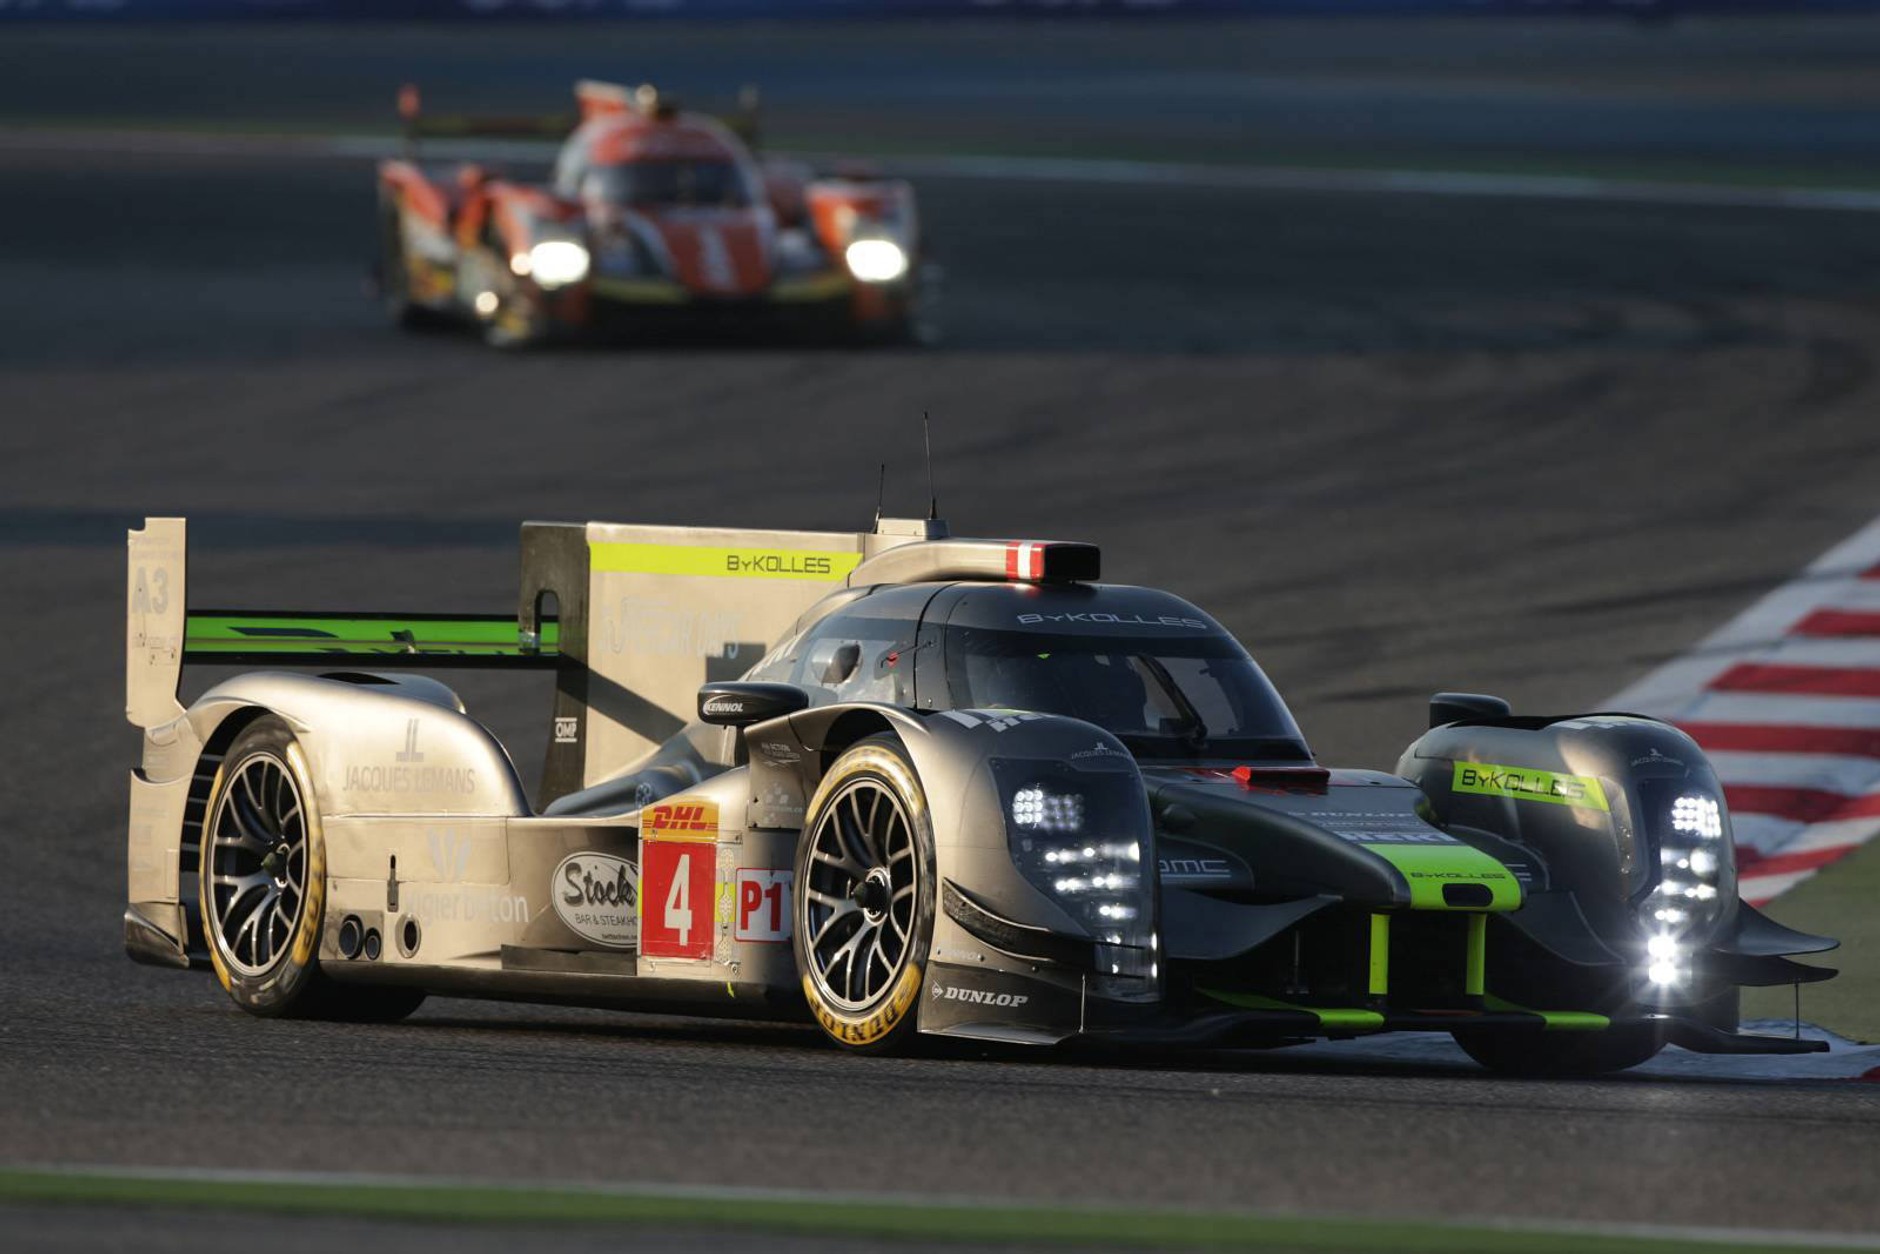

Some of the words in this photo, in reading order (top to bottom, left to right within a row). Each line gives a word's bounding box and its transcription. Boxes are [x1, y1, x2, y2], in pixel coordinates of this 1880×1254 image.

[131, 566, 169, 614] A3
[705, 702, 744, 713] KENNOL
[555, 721, 577, 738] OMP
[342, 766, 409, 792] JACQUES
[416, 767, 475, 794] LEMANS
[653, 806, 707, 830] DHL
[664, 854, 693, 947] 4
[740, 880, 783, 932] P1
[943, 986, 1029, 1008] DUNLOP
